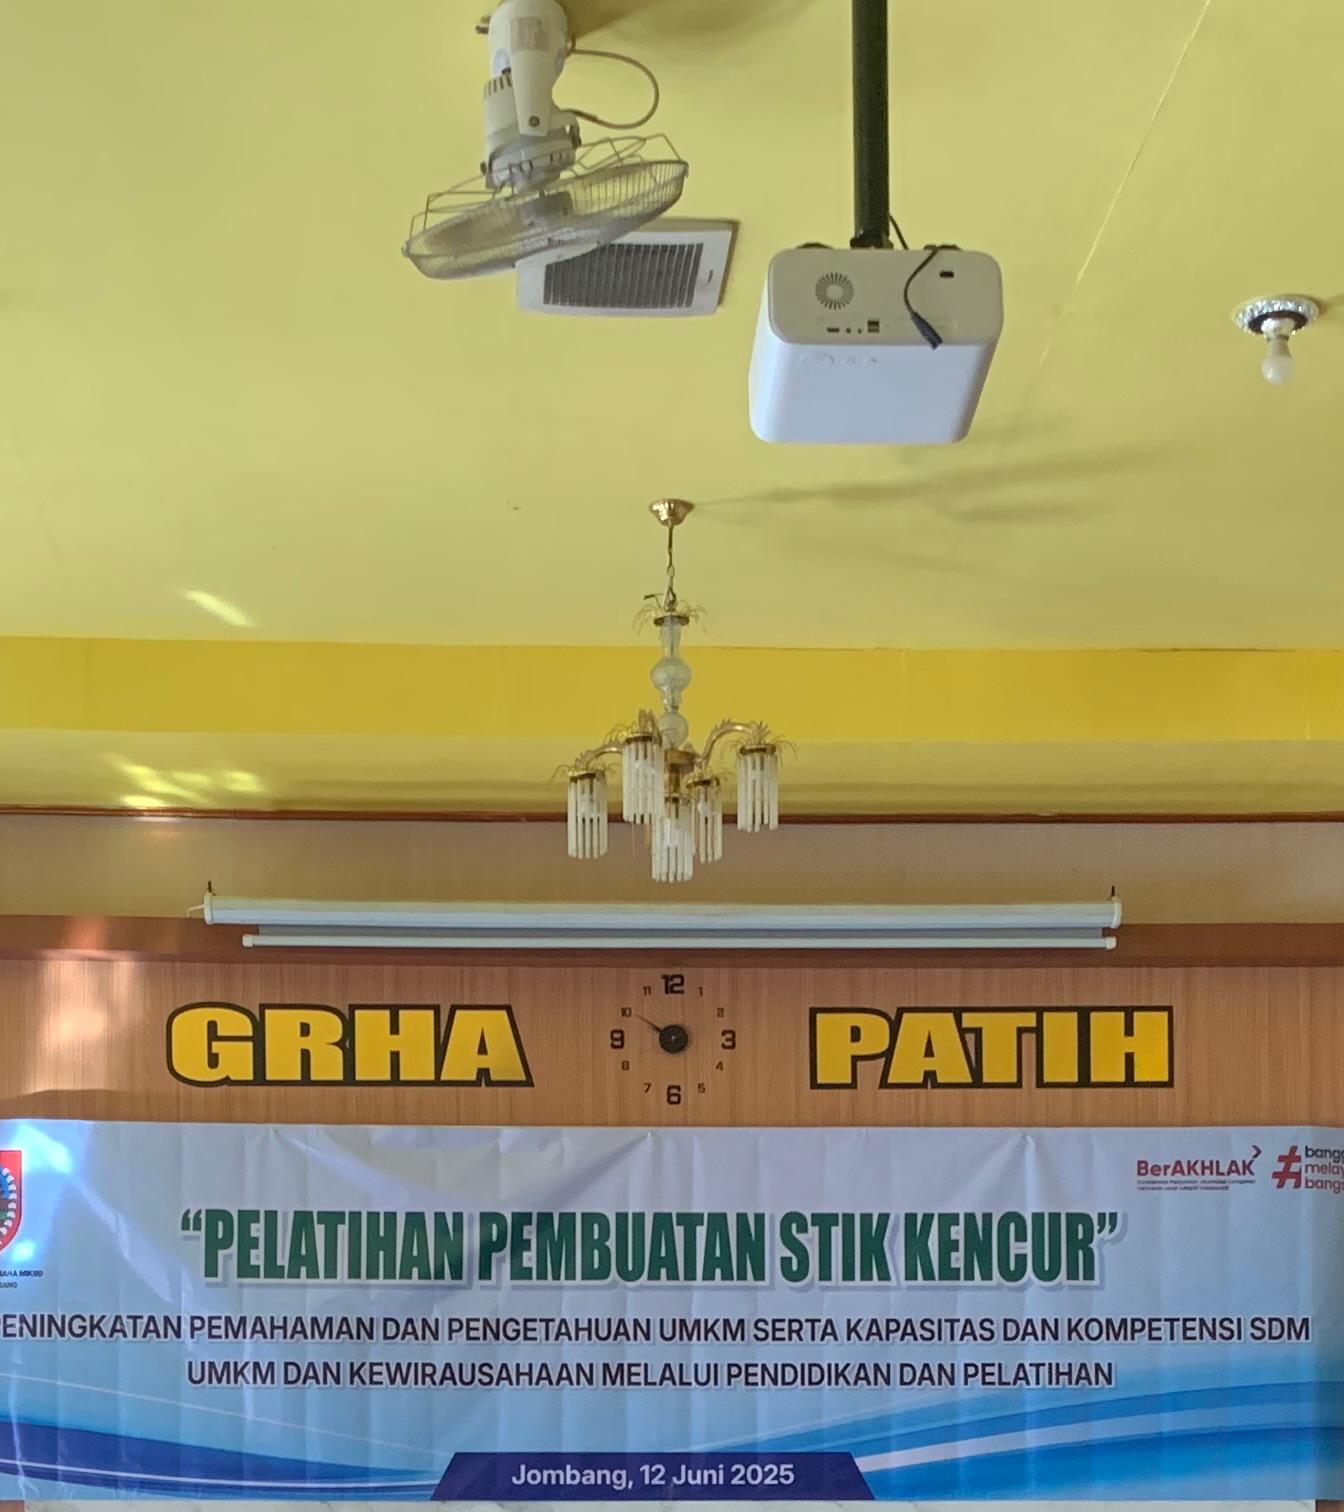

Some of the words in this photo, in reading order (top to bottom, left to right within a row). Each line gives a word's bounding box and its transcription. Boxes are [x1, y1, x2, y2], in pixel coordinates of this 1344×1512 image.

[661, 974, 685, 994] 12
[621, 1007, 632, 1017] 10
[166, 1002, 534, 1087] GRHA
[809, 1006, 1174, 1089] PATIH
[610, 1029, 625, 1050] 9
[721, 1029, 736, 1050] 3
[715, 1061, 724, 1071] 4
[644, 1082, 652, 1093] 7
[666, 1085, 682, 1105] 6
[698, 1083, 706, 1093] 5
[1136, 1159, 1256, 1177] BerAKHLAK
[479, 1211, 766, 1282] PEMBUATAN
[779, 1211, 892, 1283] STIK
[190, 1315, 375, 1341] PEMAHAMAN
[383, 1317, 440, 1342] DAN
[447, 1317, 651, 1342] PENGETAHUAN
[659, 1318, 746, 1342] UMKM
[753, 1318, 839, 1342] SERTA
[846, 1318, 996, 1342] KAPASITAS
[1003, 1318, 1059, 1342] DAN
[1067, 1317, 1242, 1342] KOMPETENSI
[1249, 1317, 1310, 1341] SDM
[187, 1361, 276, 1386] UMKM
[283, 1361, 341, 1386] DAN
[349, 1362, 594, 1387] KEWIRAUSAHAAN
[602, 1362, 719, 1387] MELALUI
[727, 1362, 891, 1387] PENDIDIKAN
[899, 1362, 955, 1386] DAN
[963, 1362, 1113, 1386] PELATIHAN
[511, 1464, 633, 1490] Jombang,
[639, 1464, 666, 1485] 12
[672, 1464, 724, 1485] Juni
[730, 1464, 795, 1486] 2025
